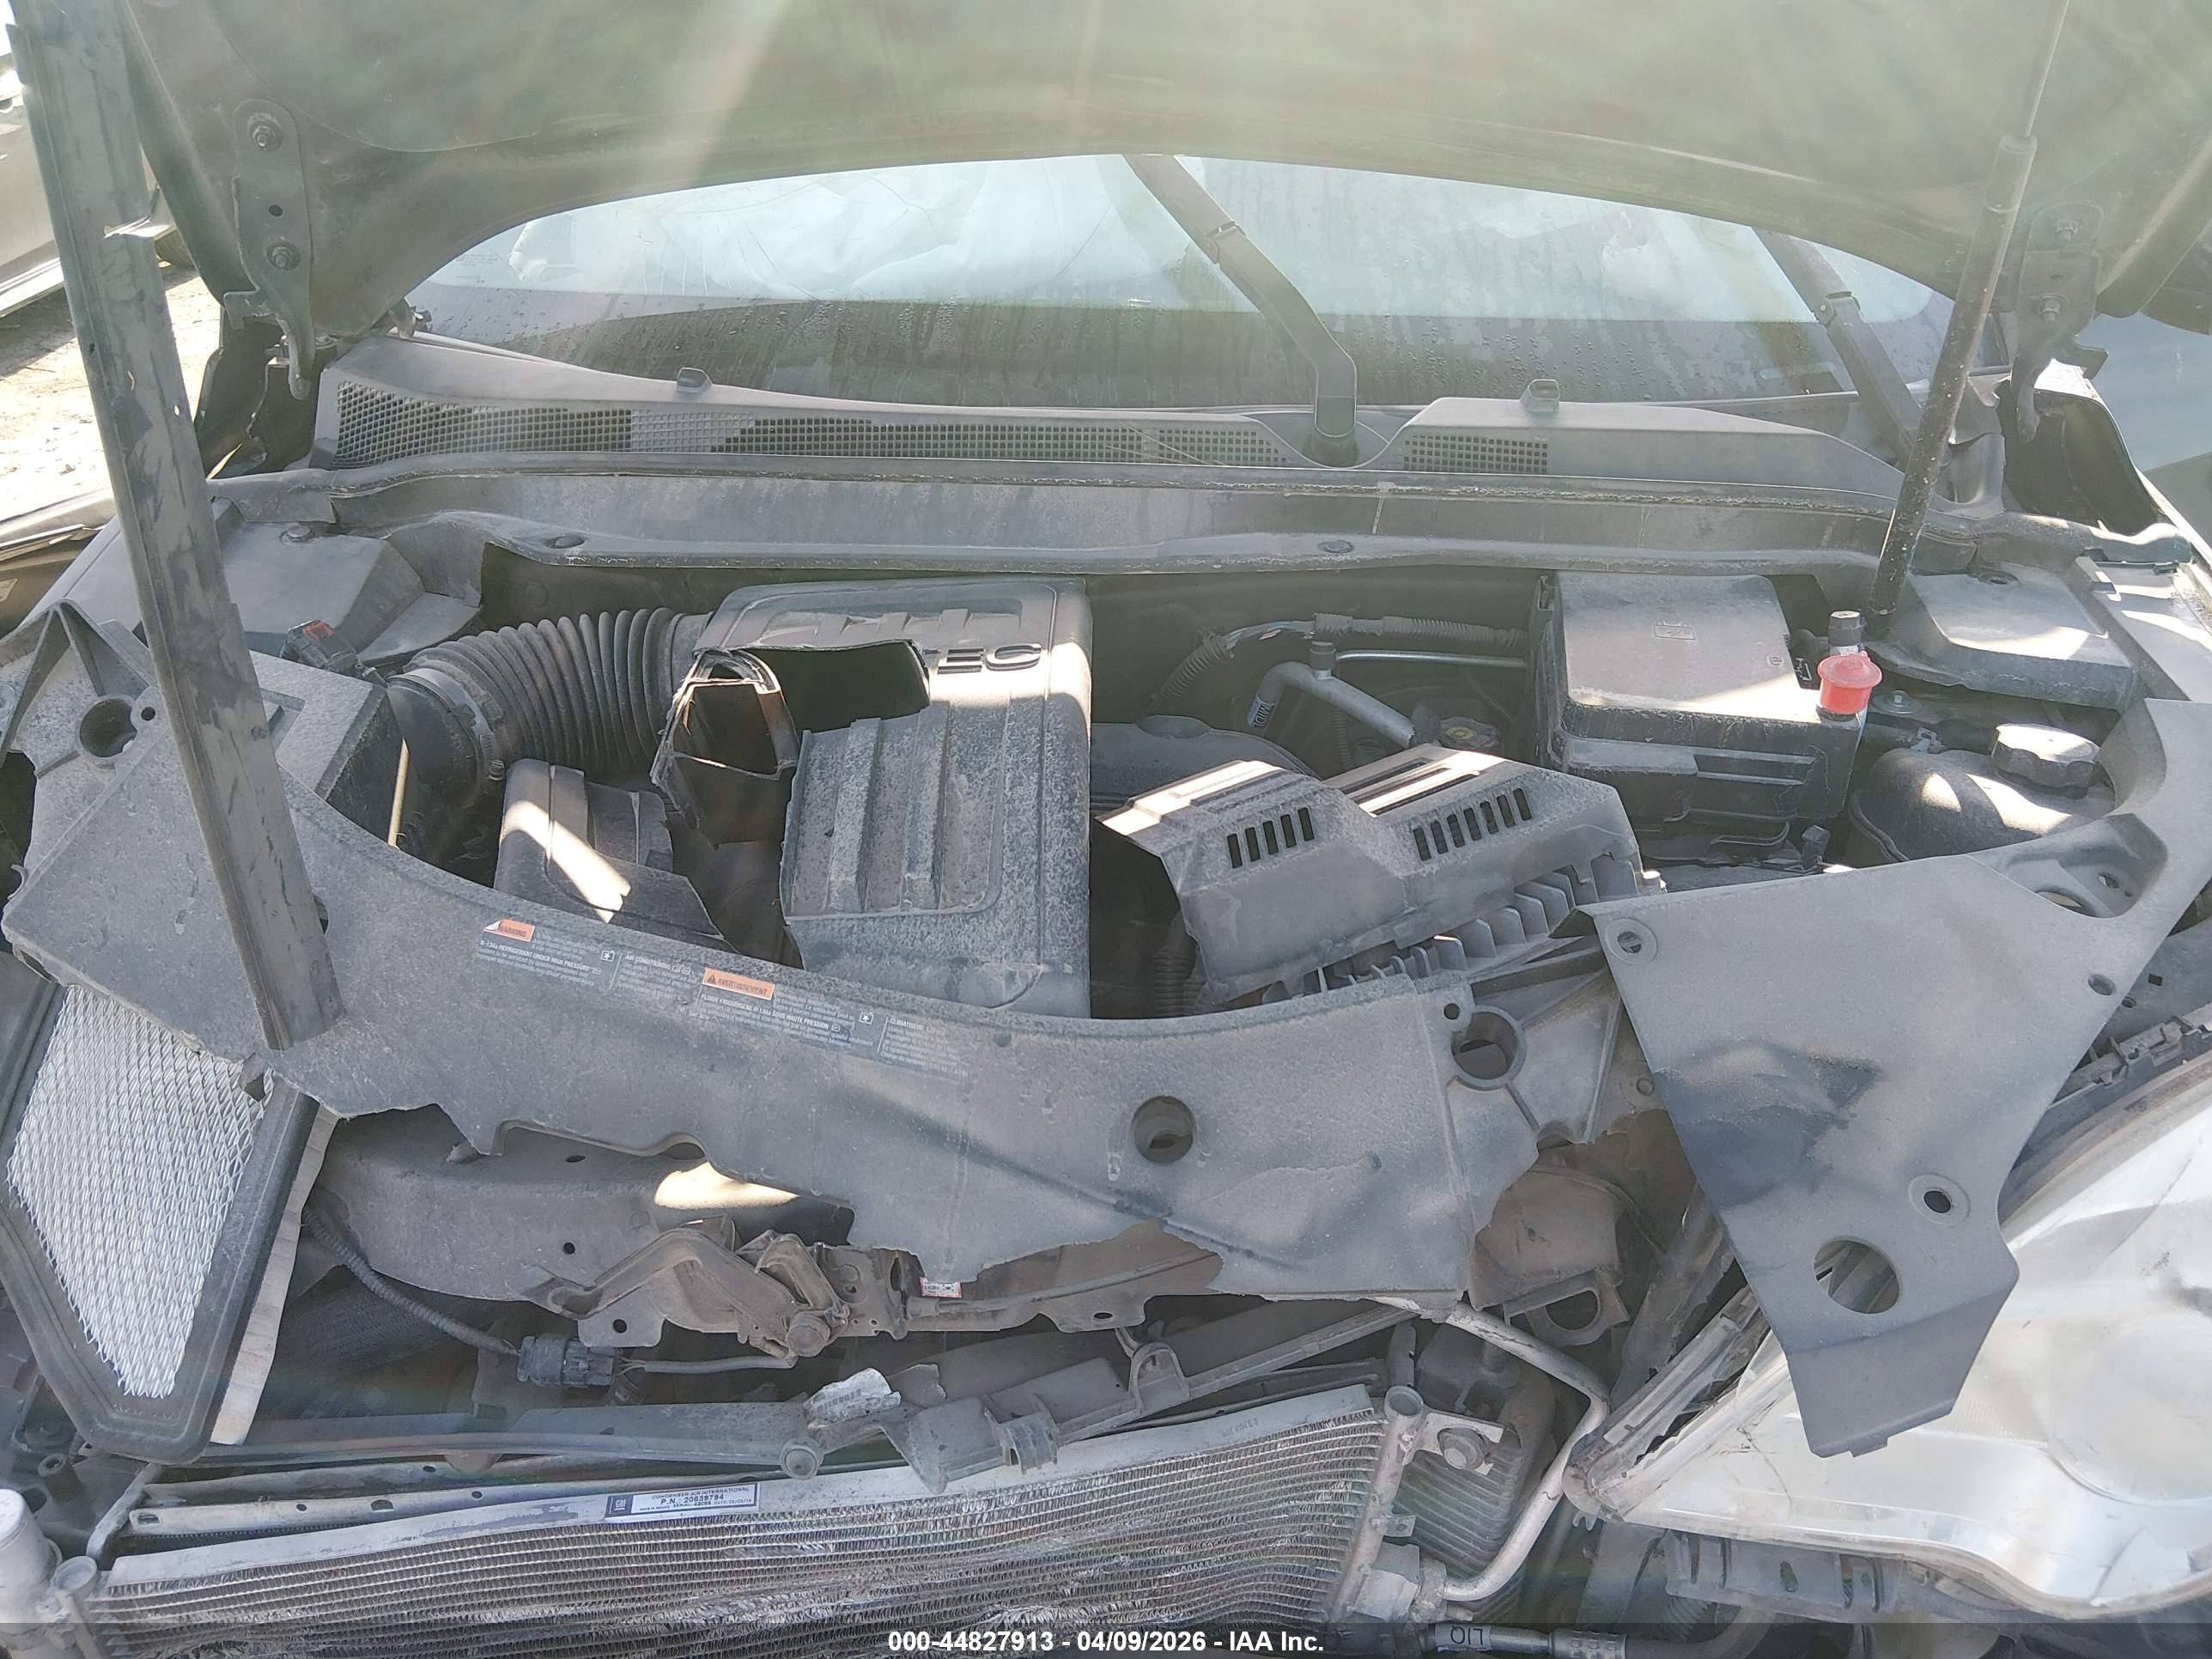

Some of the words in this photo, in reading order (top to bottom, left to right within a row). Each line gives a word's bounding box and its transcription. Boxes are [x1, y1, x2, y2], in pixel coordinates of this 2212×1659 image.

[923, 642, 1042, 675] EC
[718, 979, 769, 996] AVERTISSEMENT
[804, 1017, 830, 1030] PRESSION
[651, 1491, 690, 1499] CONDENSER
[702, 1486, 750, 1495] INTERNATIONAL
[615, 1498, 627, 1508] GM
